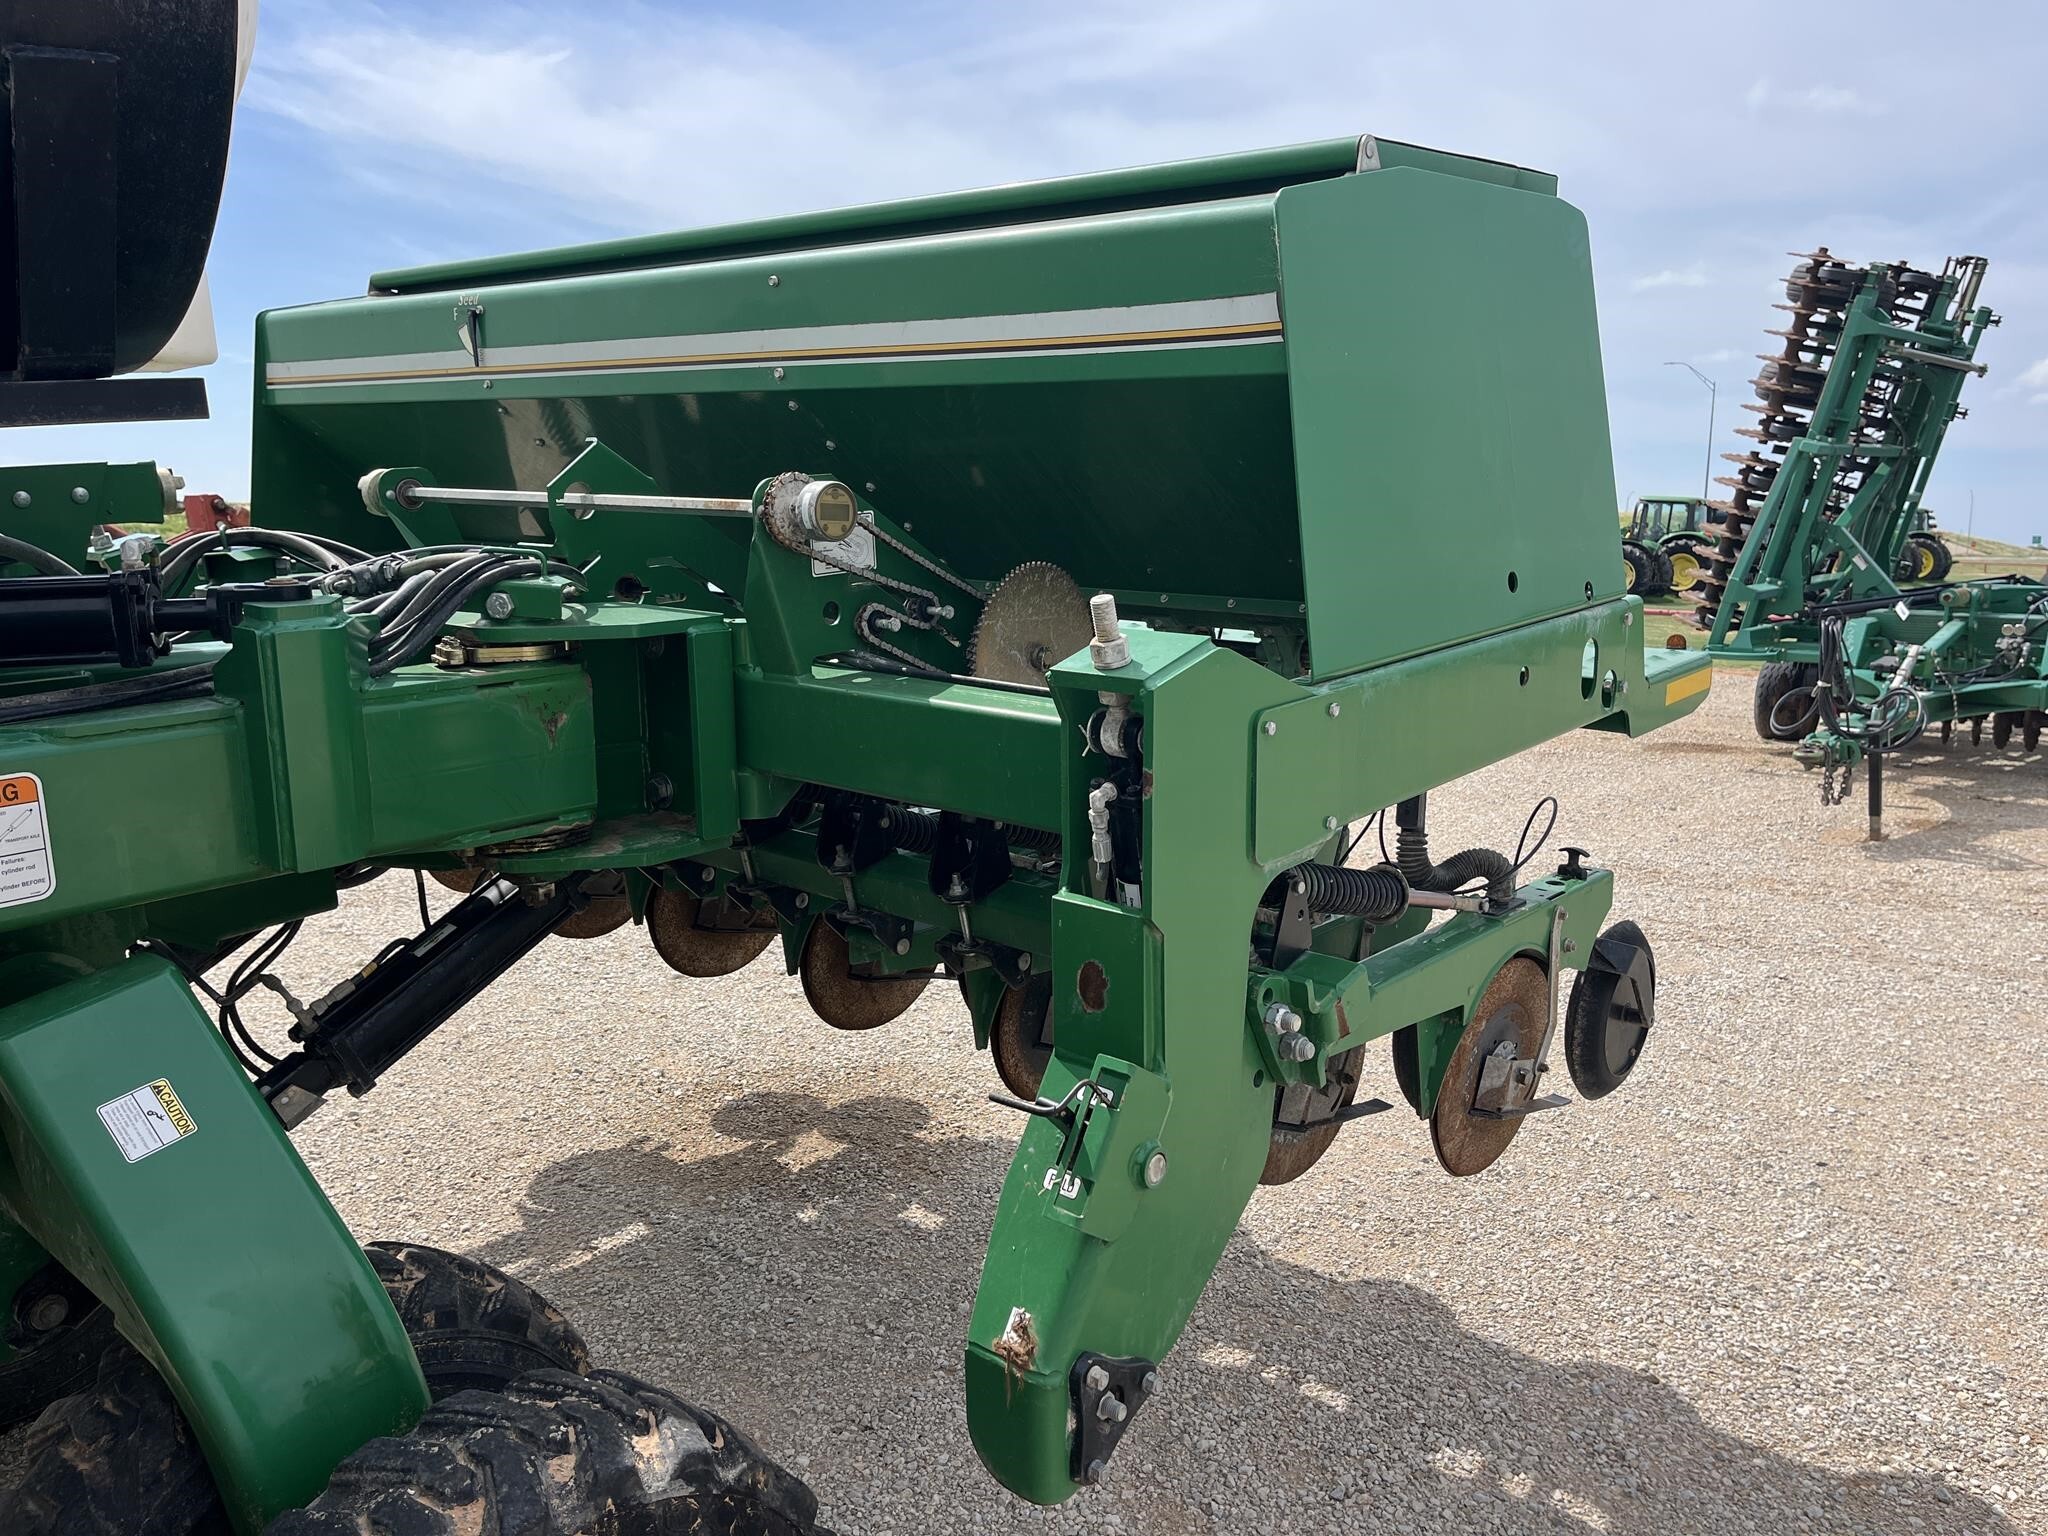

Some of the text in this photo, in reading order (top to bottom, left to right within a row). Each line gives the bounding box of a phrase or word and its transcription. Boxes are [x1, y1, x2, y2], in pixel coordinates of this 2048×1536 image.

[458, 294, 479, 306] Seed
[453, 307, 458, 320] F
[0, 782, 19, 802] G
[1, 867, 24, 876] cylinder
[0, 878, 46, 892] ylinder BEFORE
[160, 1092, 193, 1134] CAUTION
